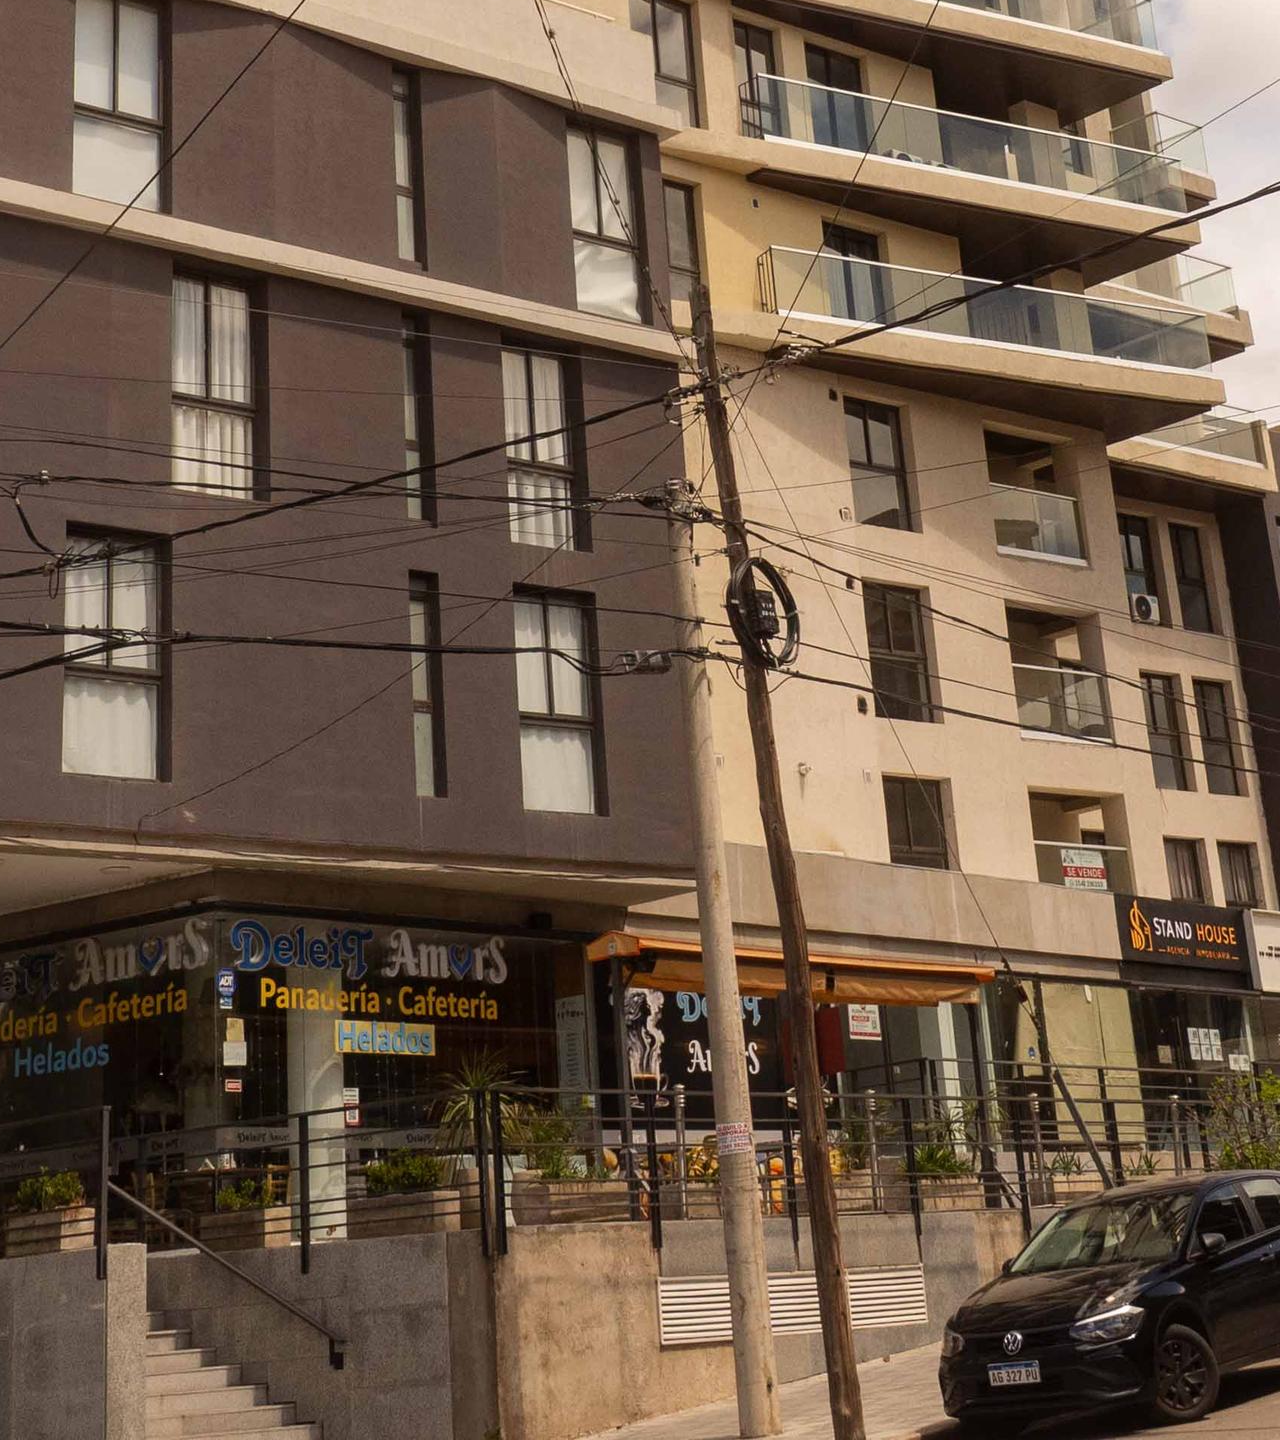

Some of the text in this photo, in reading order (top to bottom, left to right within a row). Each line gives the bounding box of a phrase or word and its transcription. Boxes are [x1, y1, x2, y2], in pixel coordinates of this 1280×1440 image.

[1067, 867, 1103, 878] SE VENDE
[1153, 917, 1237, 945] STAND HOUSE
[77, 982, 188, 1029] Cafetería
[260, 977, 499, 1021] Panadería Cafetería
[337, 1022, 433, 1055] Helados
[14, 1038, 111, 1078] Helados
[992, 1368, 1038, 1384] AG 327 PU
